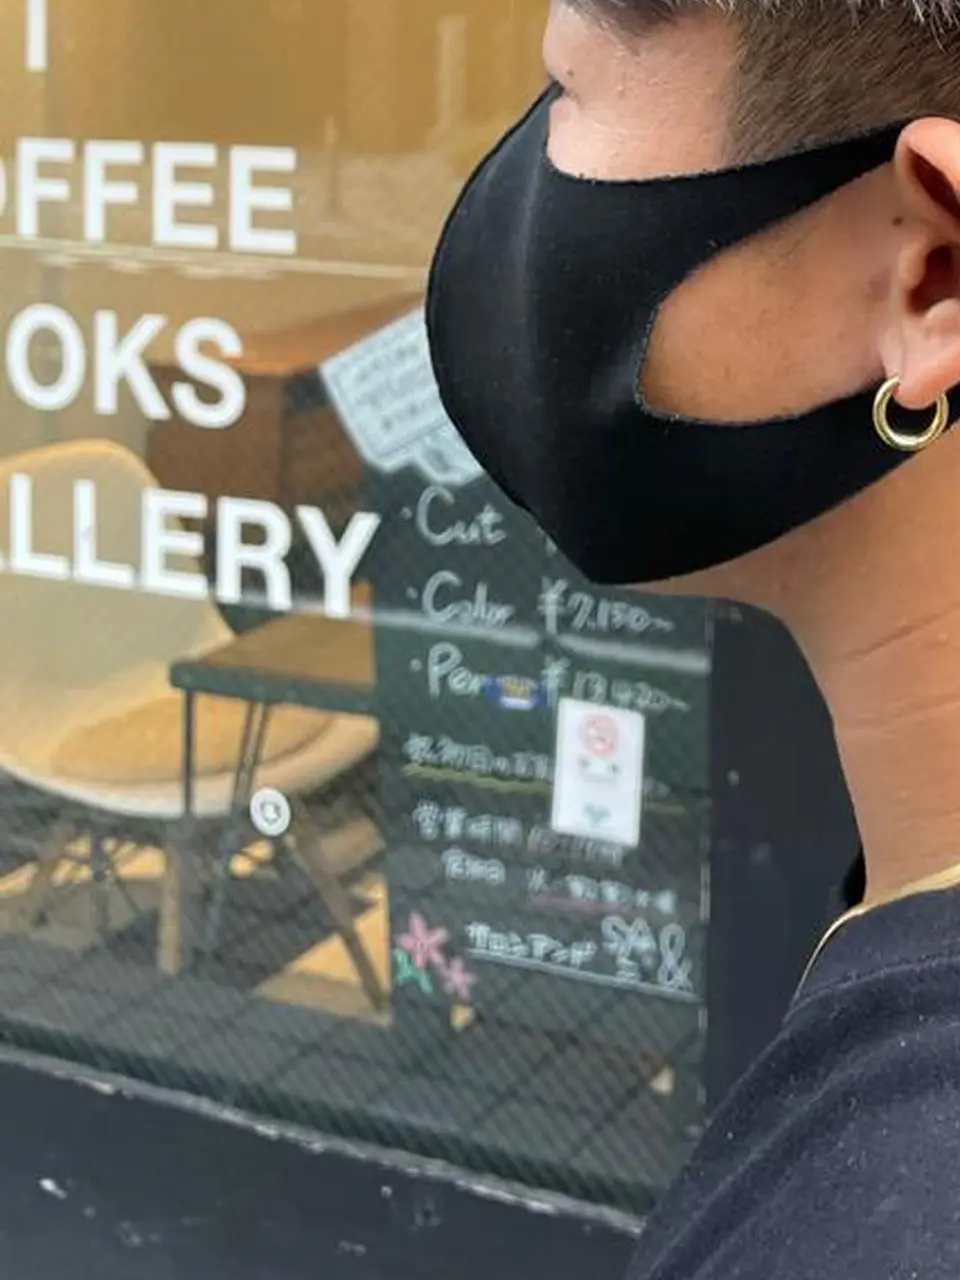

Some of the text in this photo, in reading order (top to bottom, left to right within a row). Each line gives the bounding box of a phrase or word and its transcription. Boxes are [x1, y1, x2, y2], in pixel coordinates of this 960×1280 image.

[0, 137, 297, 255] FFEE
[6, 302, 246, 430] OKS
[0, 472, 381, 619] LLERY
[416, 485, 506, 546] Cut
